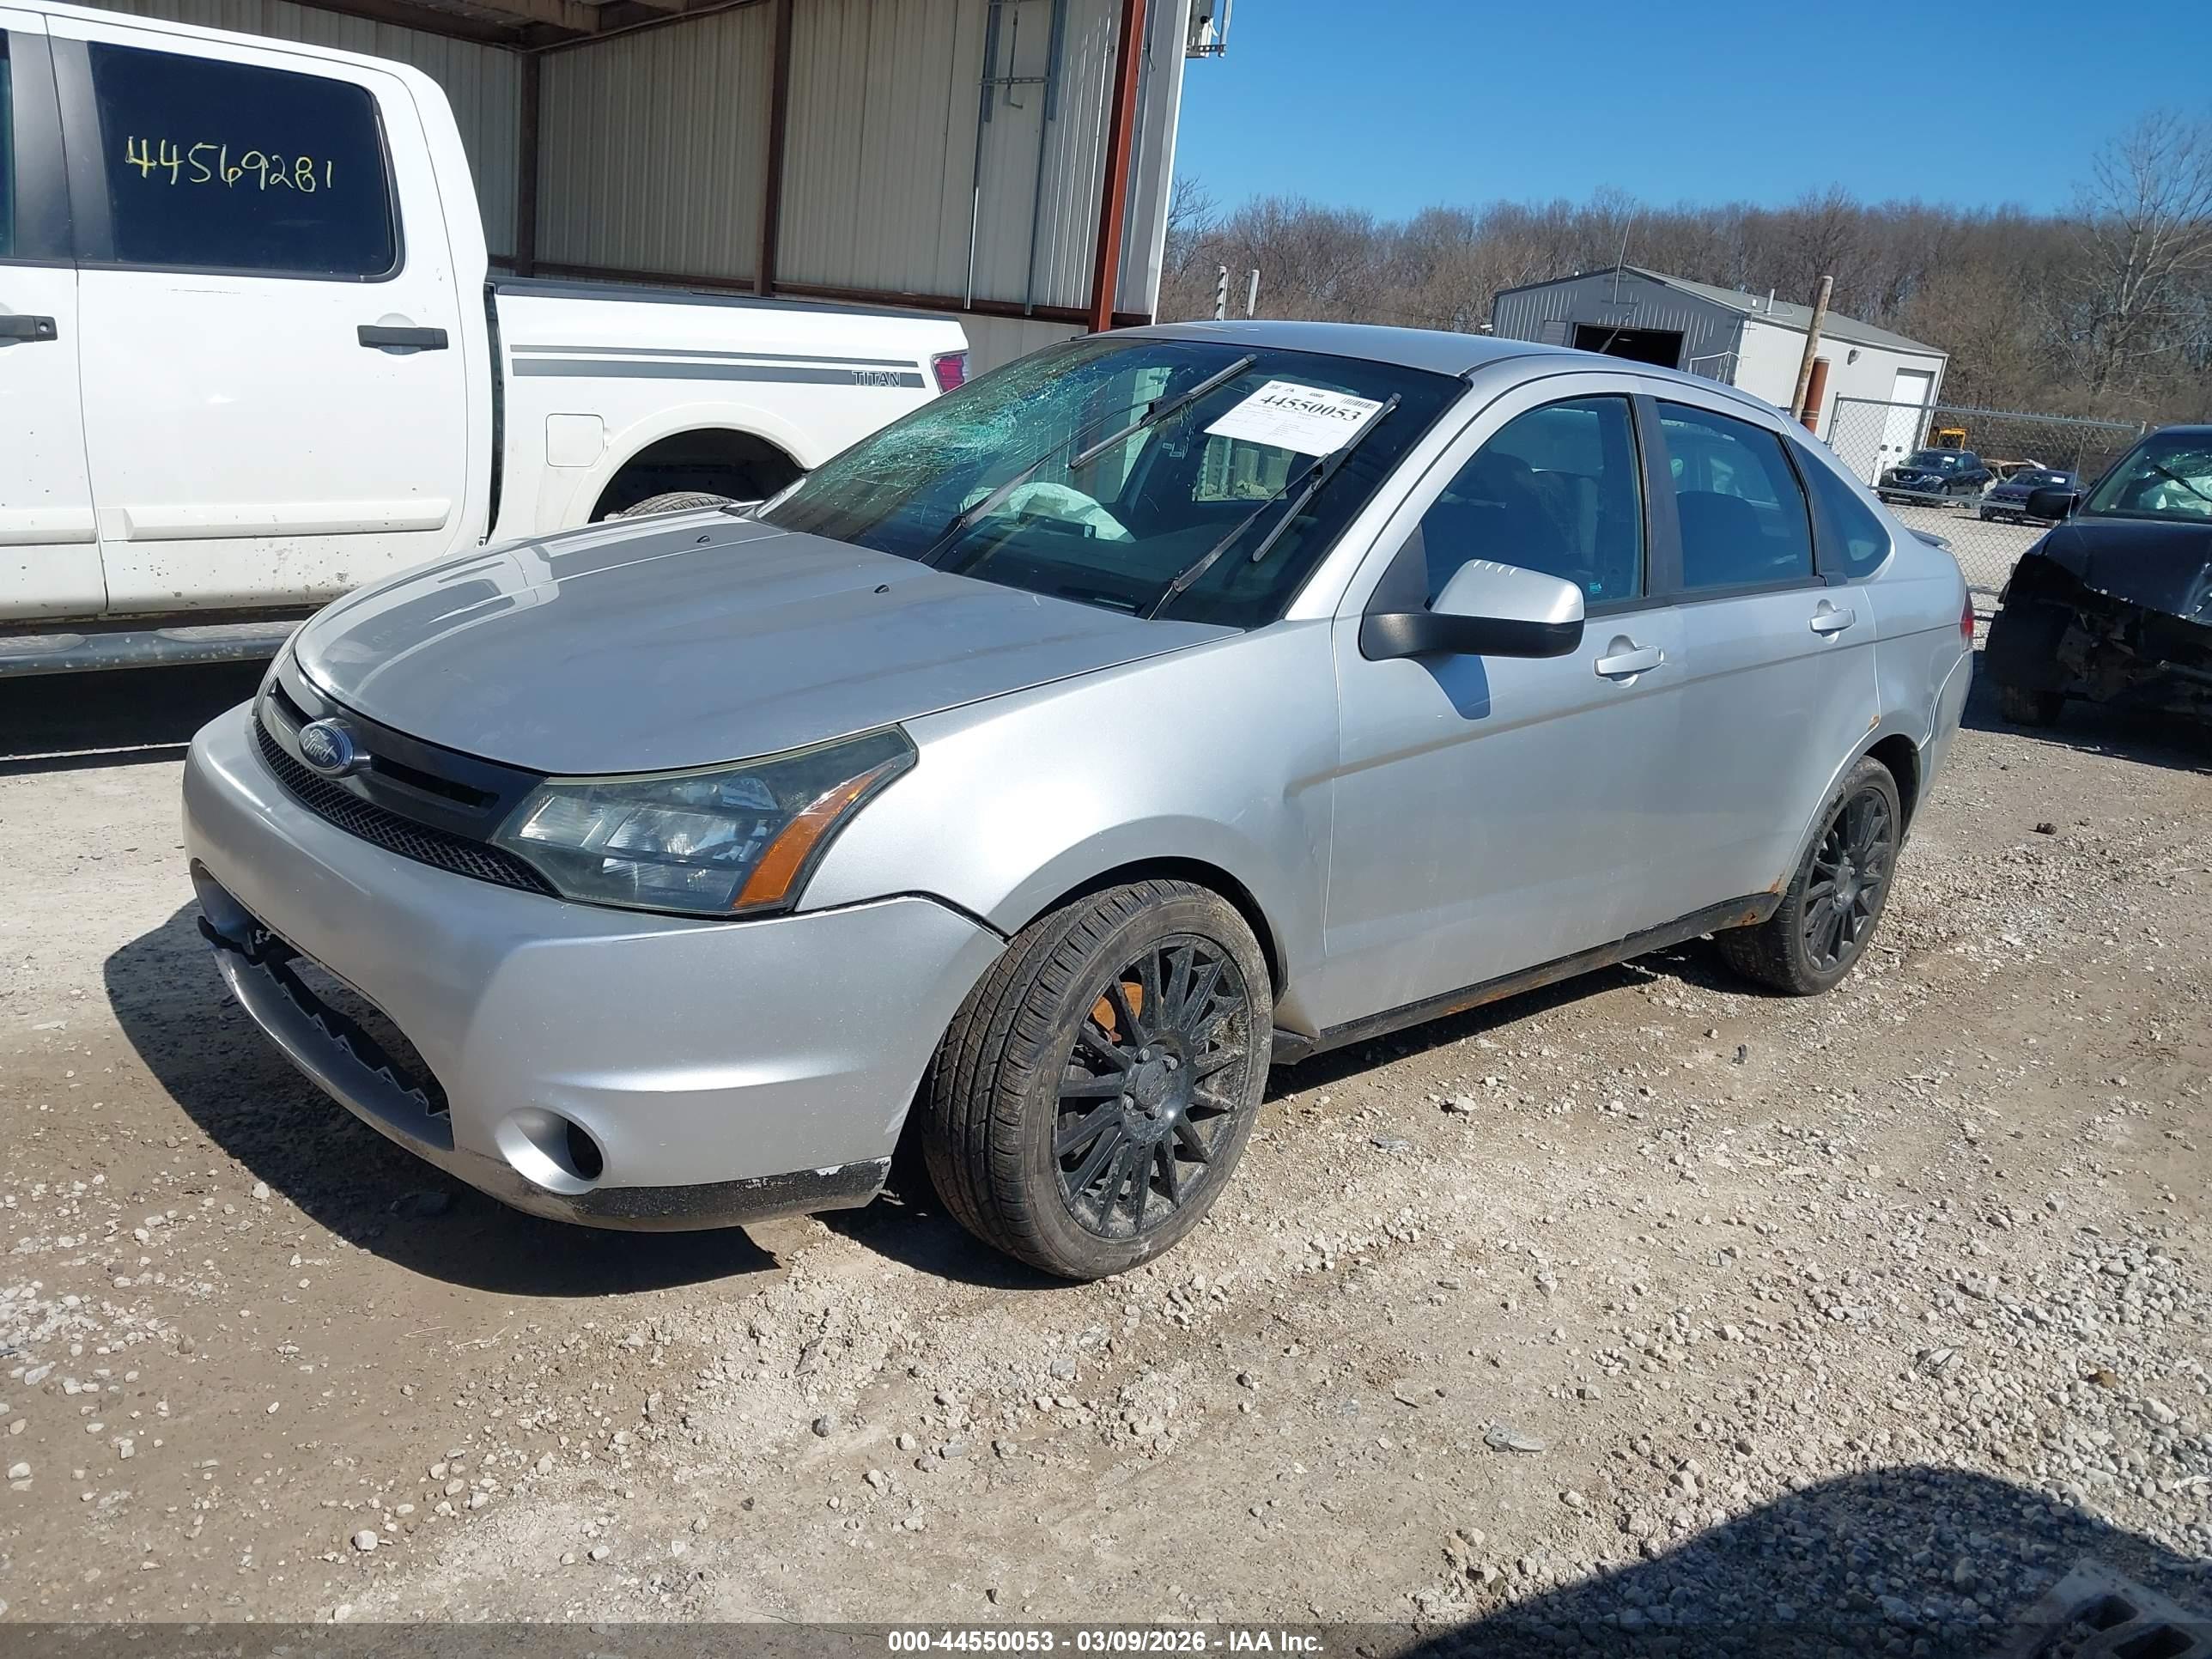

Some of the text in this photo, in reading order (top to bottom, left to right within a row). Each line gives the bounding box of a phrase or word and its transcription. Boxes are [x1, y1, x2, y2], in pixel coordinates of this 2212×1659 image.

[125, 136, 332, 192] 44569281
[852, 370, 901, 387] TITAN
[1260, 394, 1362, 422] 44550053
[303, 728, 334, 763] Ford
